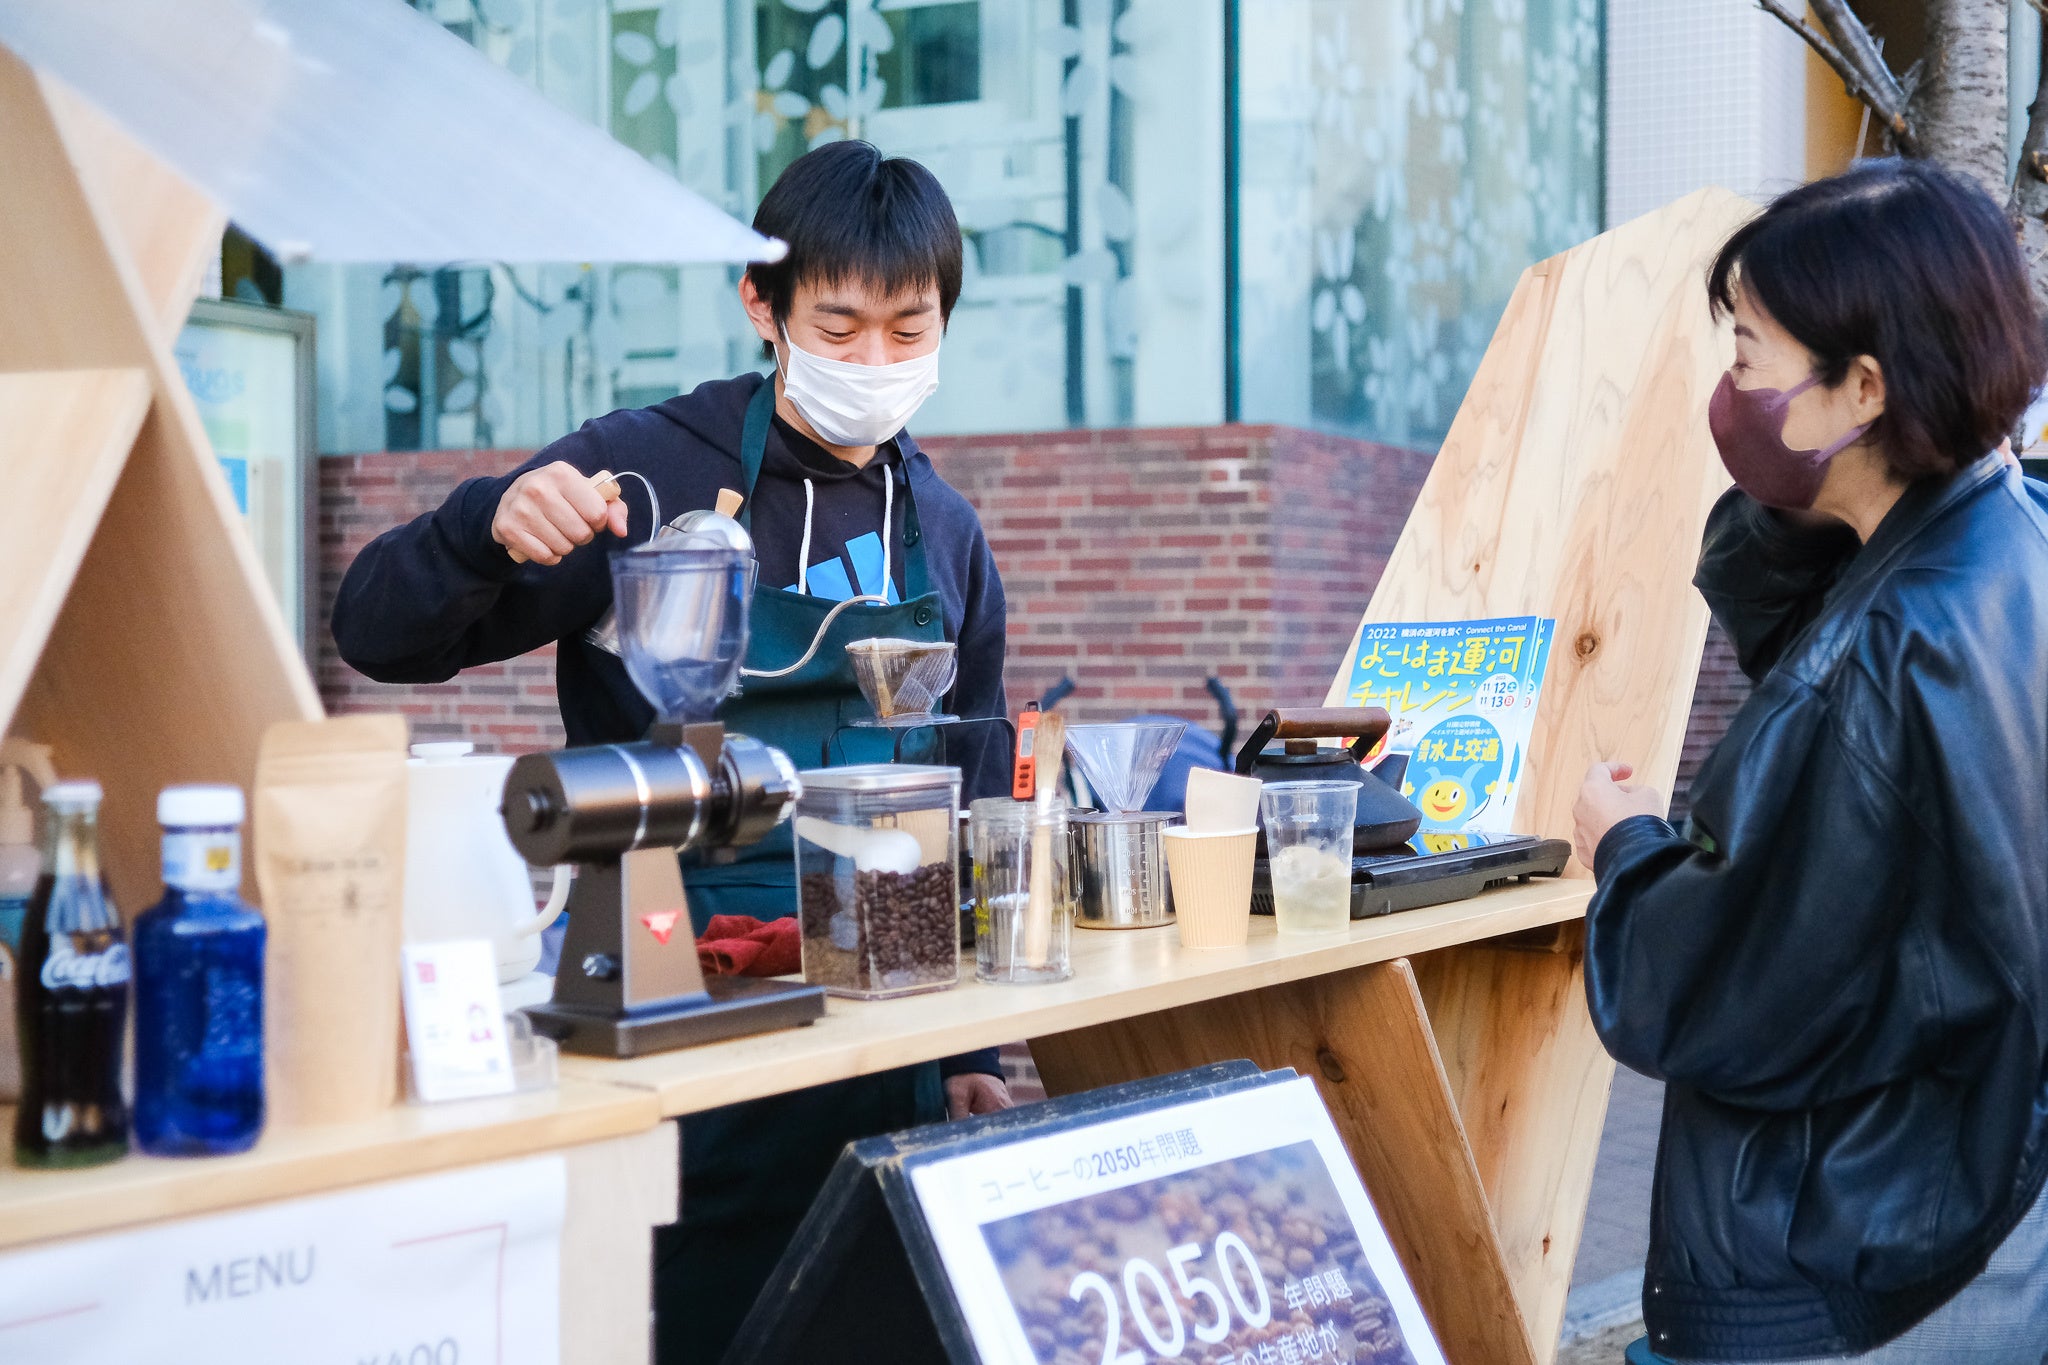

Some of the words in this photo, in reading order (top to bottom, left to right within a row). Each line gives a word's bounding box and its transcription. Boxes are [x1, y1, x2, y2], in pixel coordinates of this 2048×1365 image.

[1367, 627, 1397, 640] 2022
[1465, 626, 1493, 635] Connect
[1495, 625, 1506, 633] the
[1507, 623, 1527, 632] Canal
[1360, 636, 1526, 677] よこはま運河
[1352, 679, 1477, 713] チャレンジ
[1491, 696, 1503, 708] 13
[1495, 682, 1506, 694] 12
[981, 1127, 1203, 1203] コーヒーの2050年問題
[185, 1243, 317, 1307] MENU
[1069, 1231, 1271, 1365] 2050
[1283, 1268, 1353, 1313] 年問題
